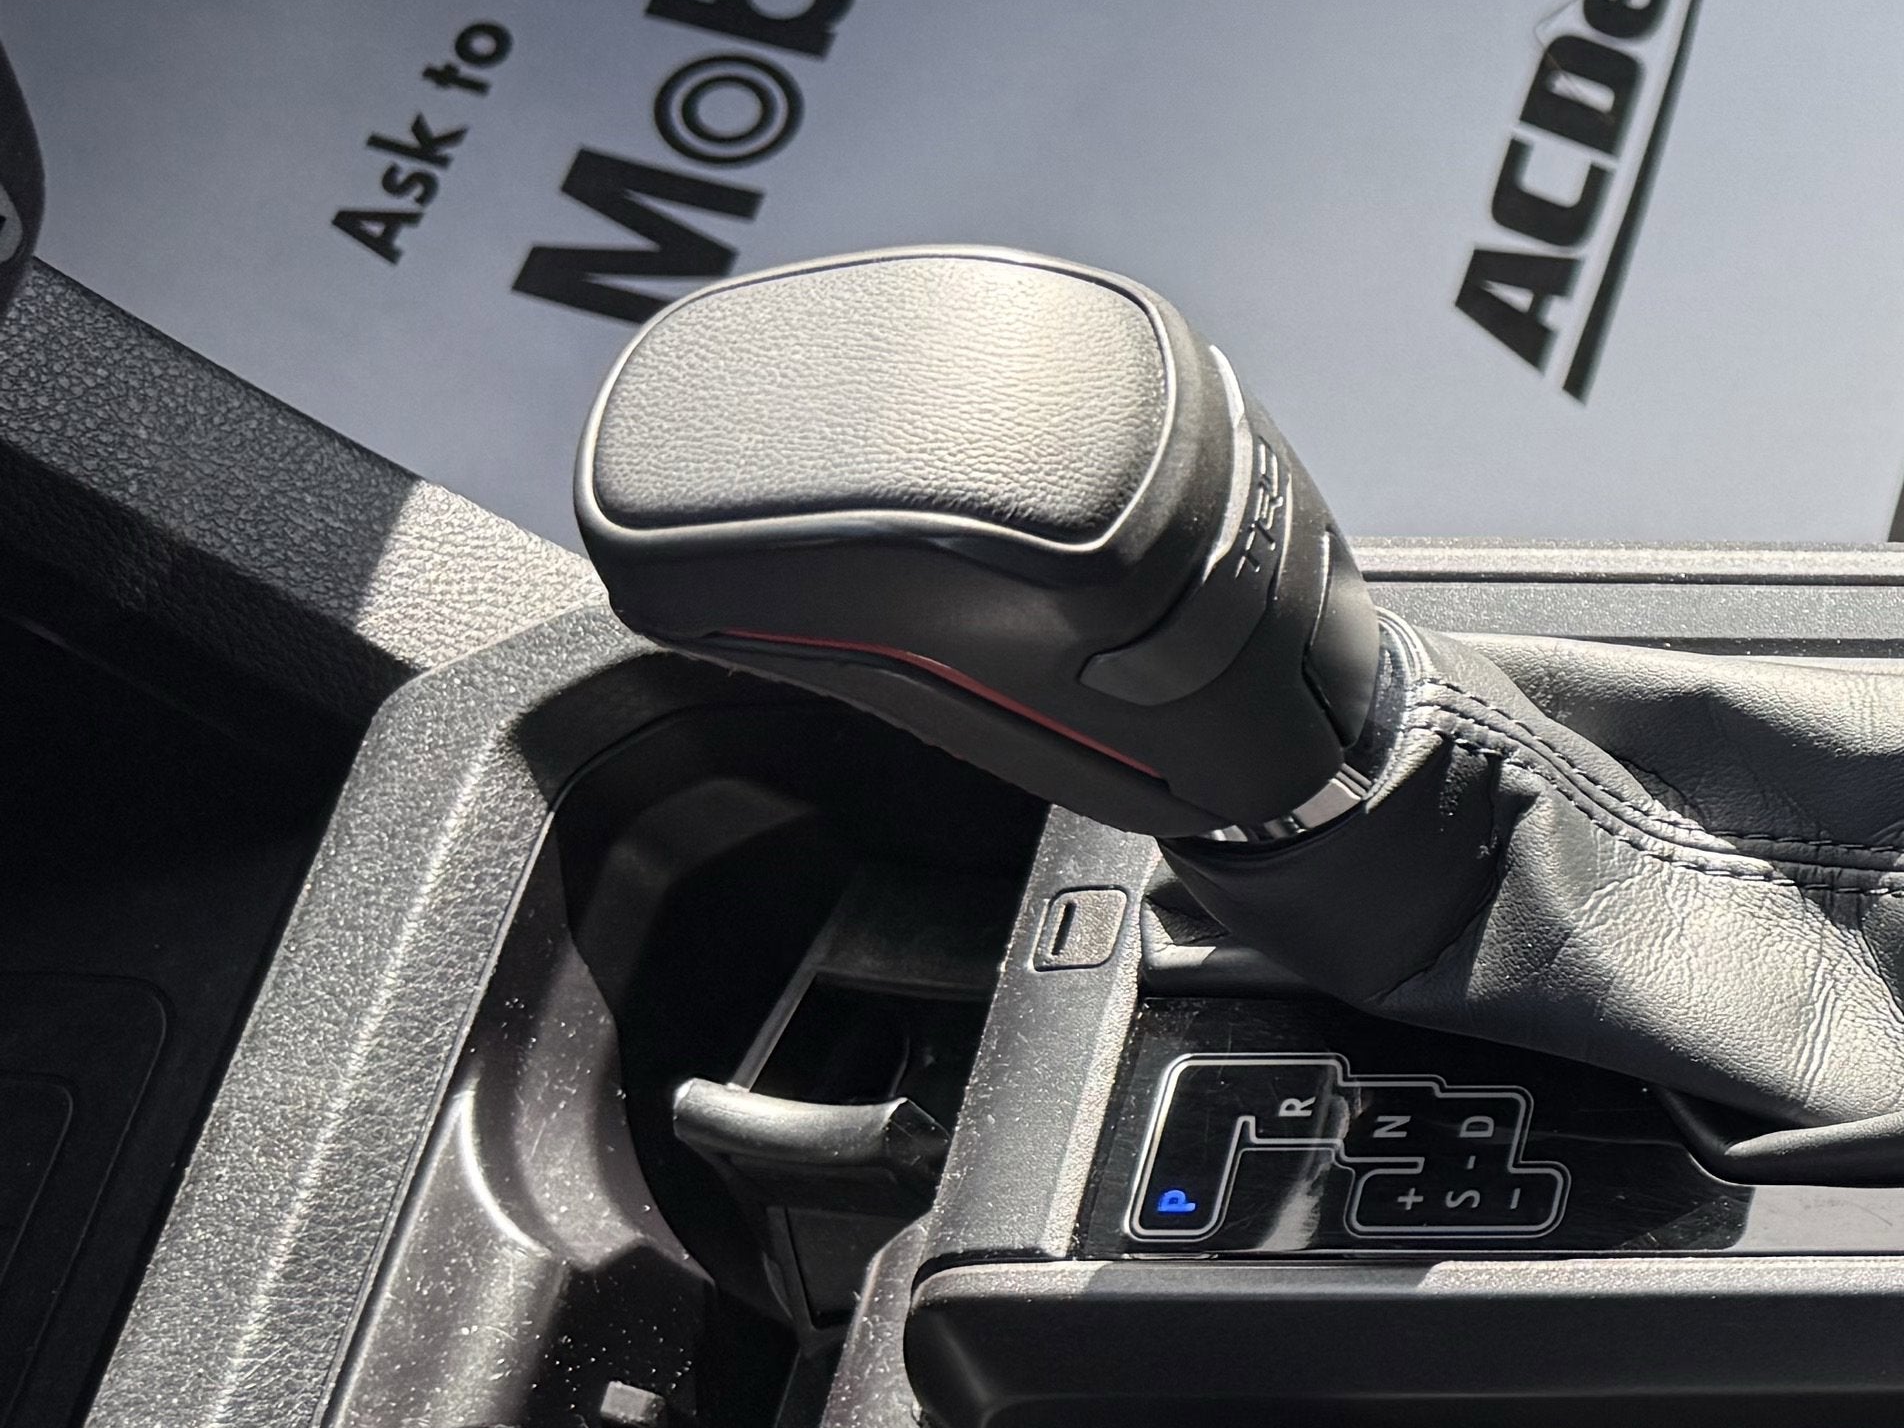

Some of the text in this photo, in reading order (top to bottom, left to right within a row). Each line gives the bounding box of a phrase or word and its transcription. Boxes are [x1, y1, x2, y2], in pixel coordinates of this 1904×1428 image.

[331, 114, 467, 264] Ask
[422, 22, 513, 95] to
[1278, 1096, 1316, 1117] R
[1372, 1115, 1411, 1138] N
[1459, 1115, 1495, 1138] D
[1157, 1189, 1196, 1212] P
[1445, 1189, 1481, 1208] S
